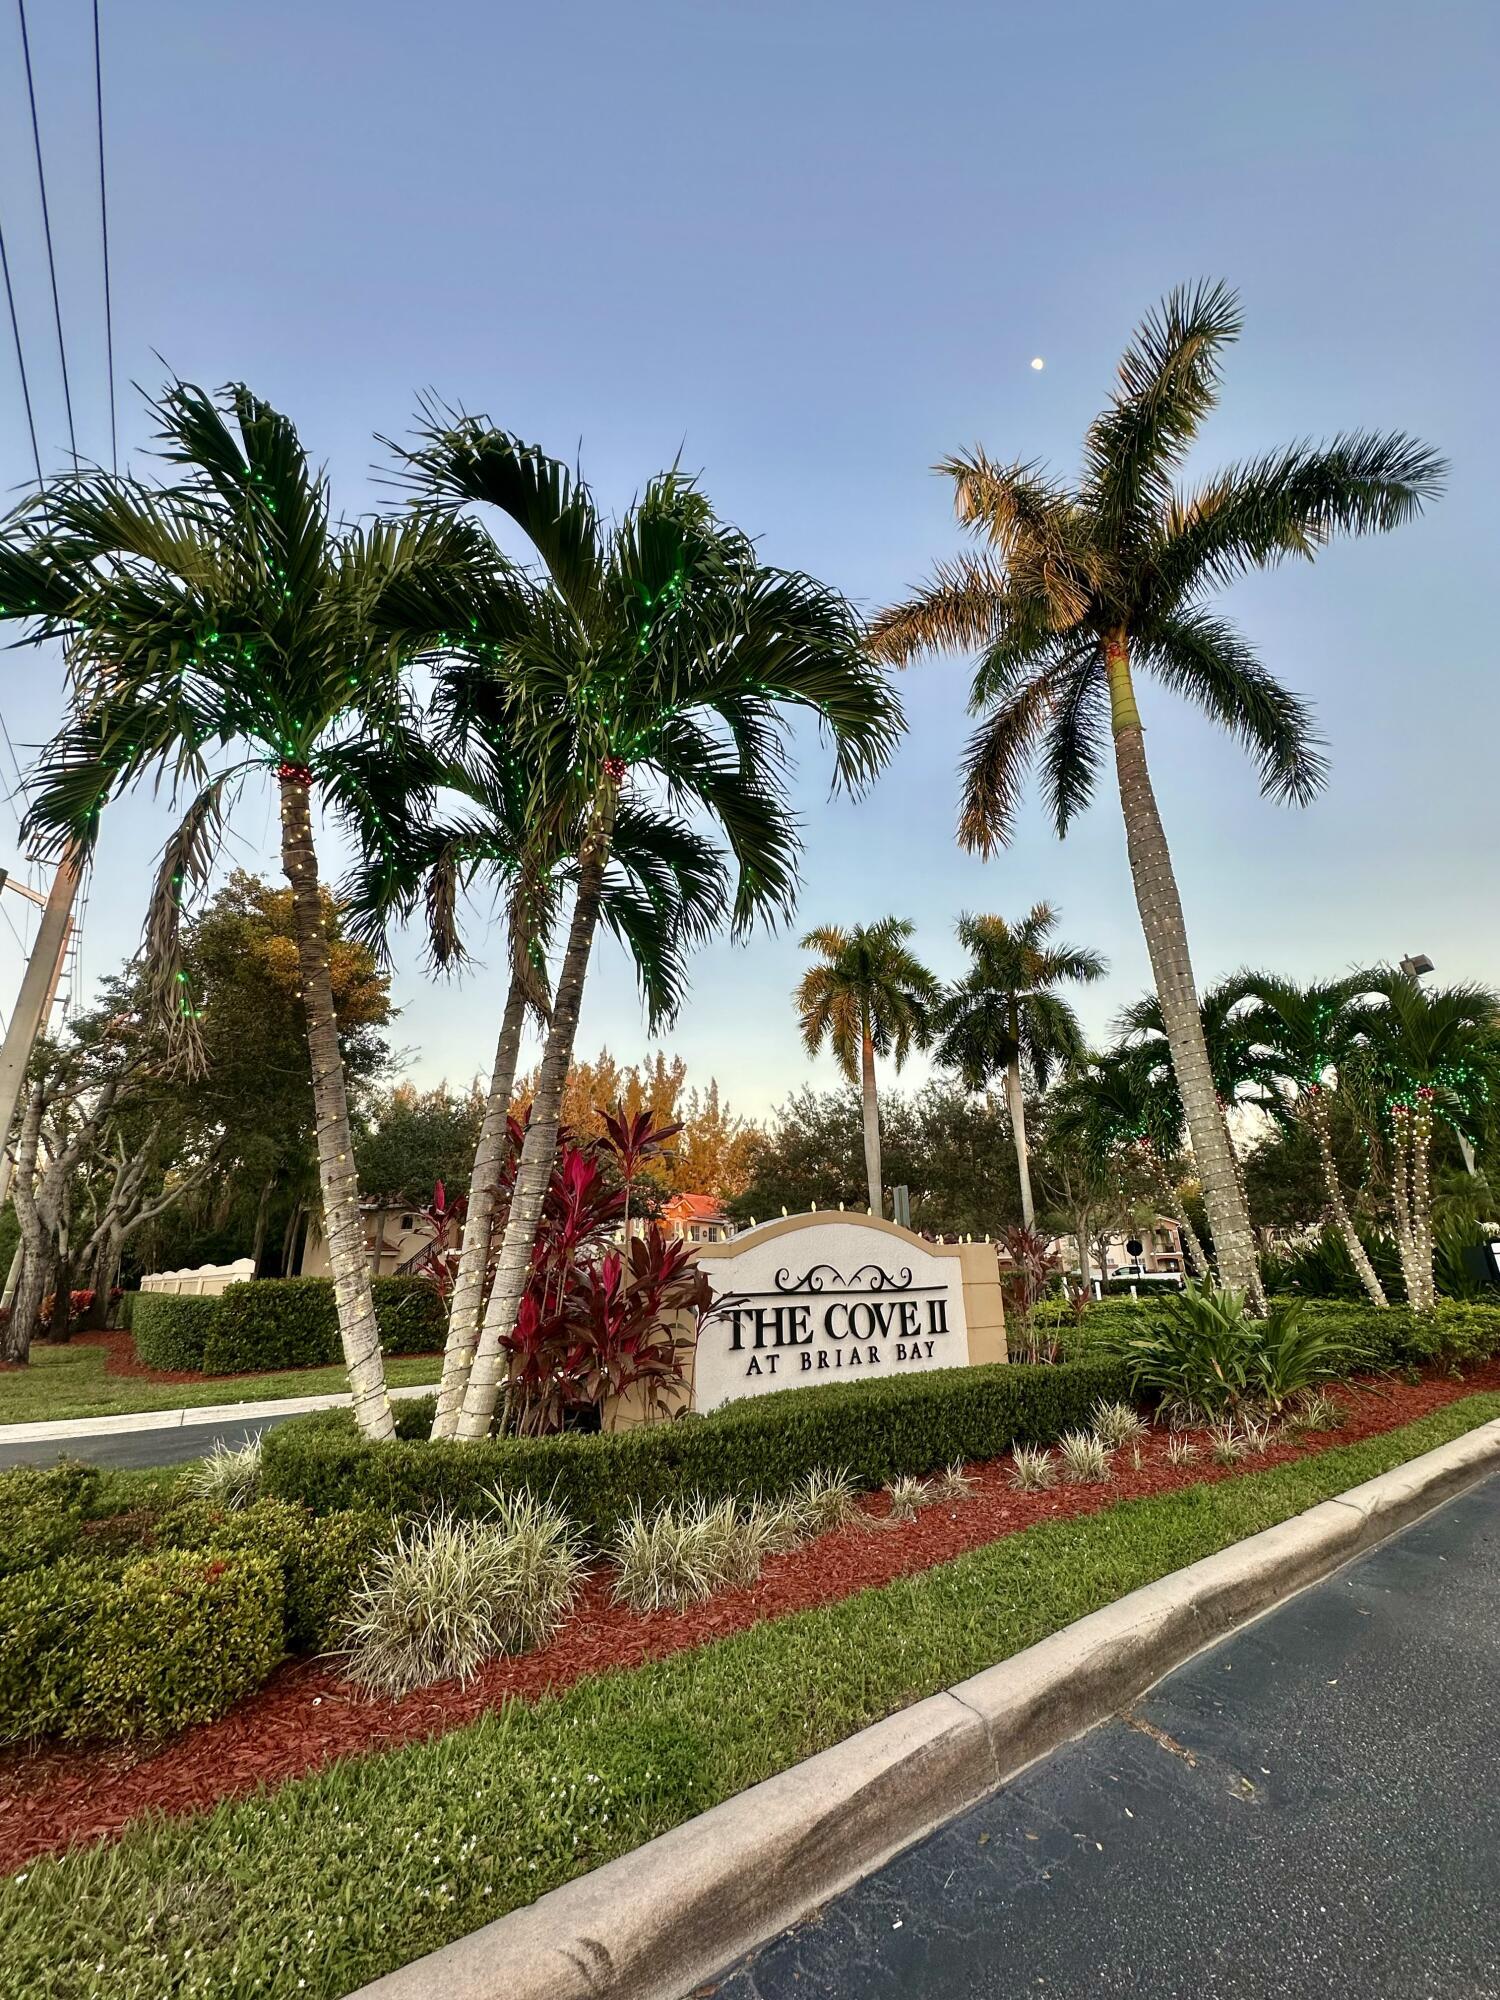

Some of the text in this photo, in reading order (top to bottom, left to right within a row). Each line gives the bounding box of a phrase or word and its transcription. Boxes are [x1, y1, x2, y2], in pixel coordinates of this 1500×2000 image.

[720, 1299, 950, 1351] THE COVE II
[746, 1340, 935, 1376] AT BRIAR BAY
